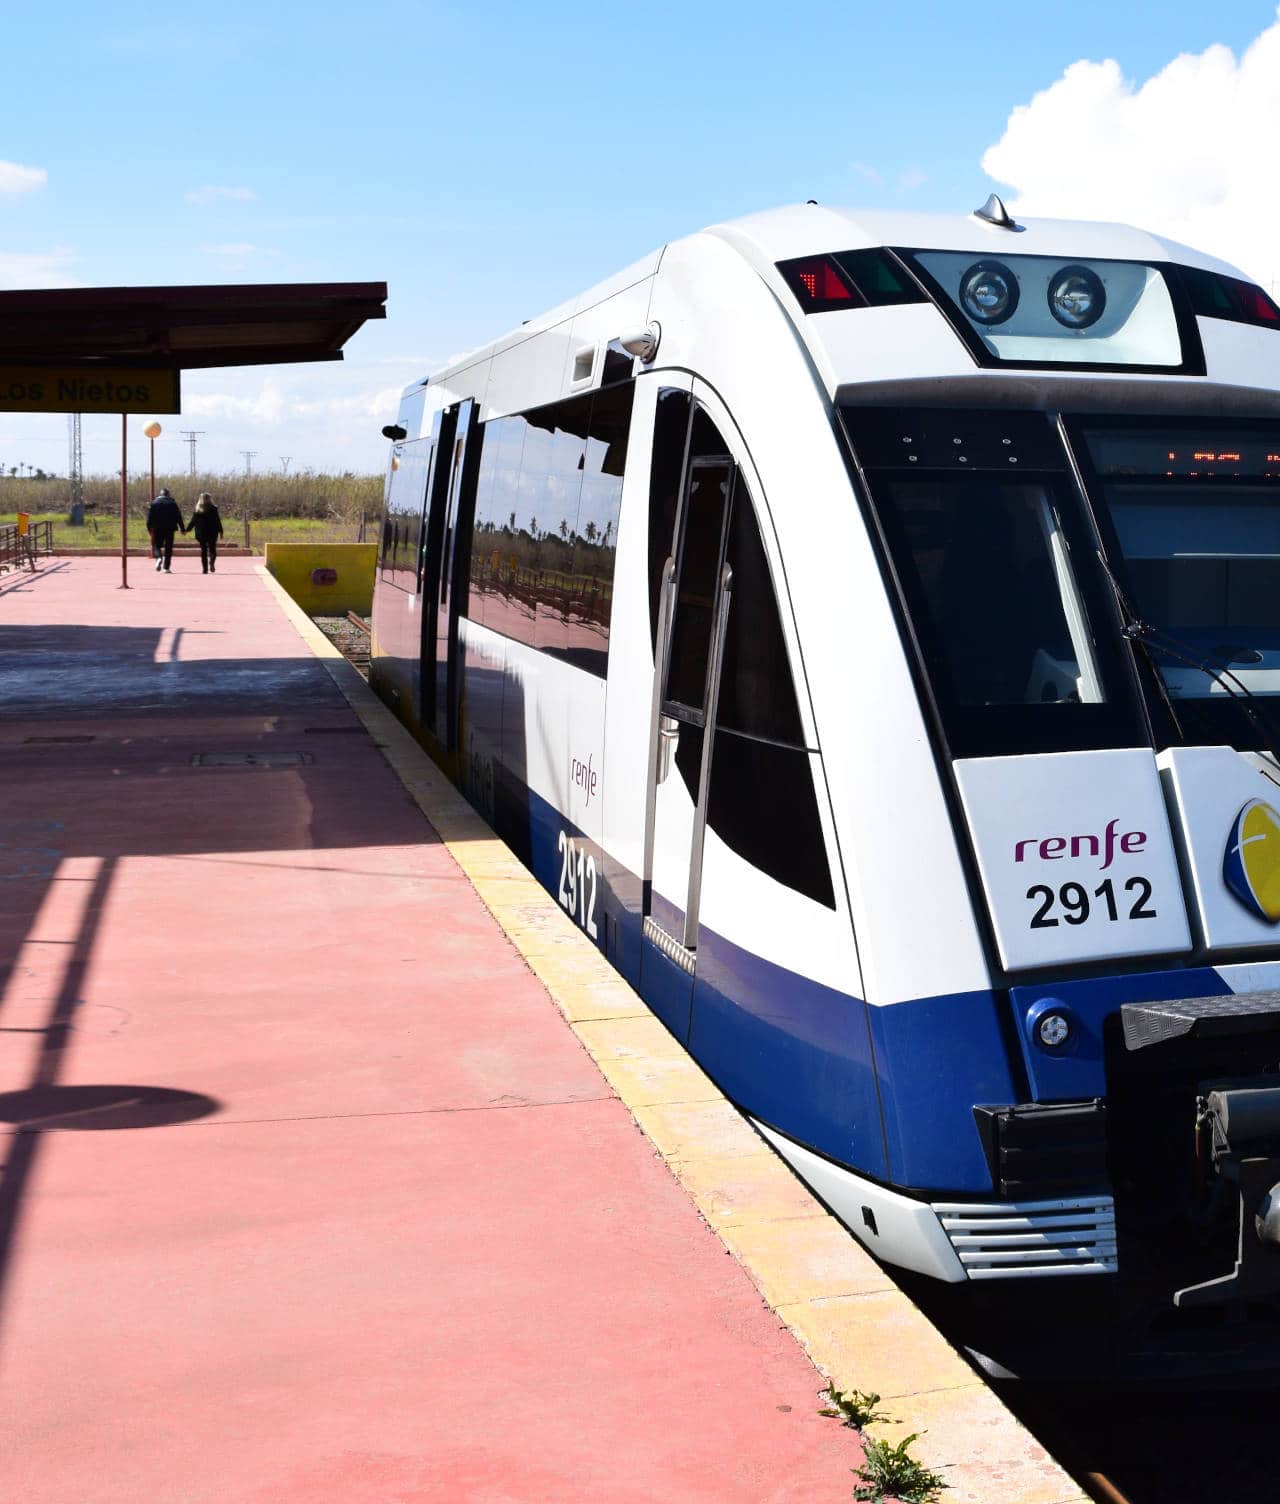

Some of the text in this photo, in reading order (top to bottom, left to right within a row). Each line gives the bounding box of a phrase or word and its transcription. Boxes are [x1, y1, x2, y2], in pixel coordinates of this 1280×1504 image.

[57, 377, 150, 402] Nietos
[571, 753, 597, 807] renfe
[1014, 818, 1148, 870] renfe
[558, 830, 598, 940] 2912
[1026, 876, 1157, 929] 2912
